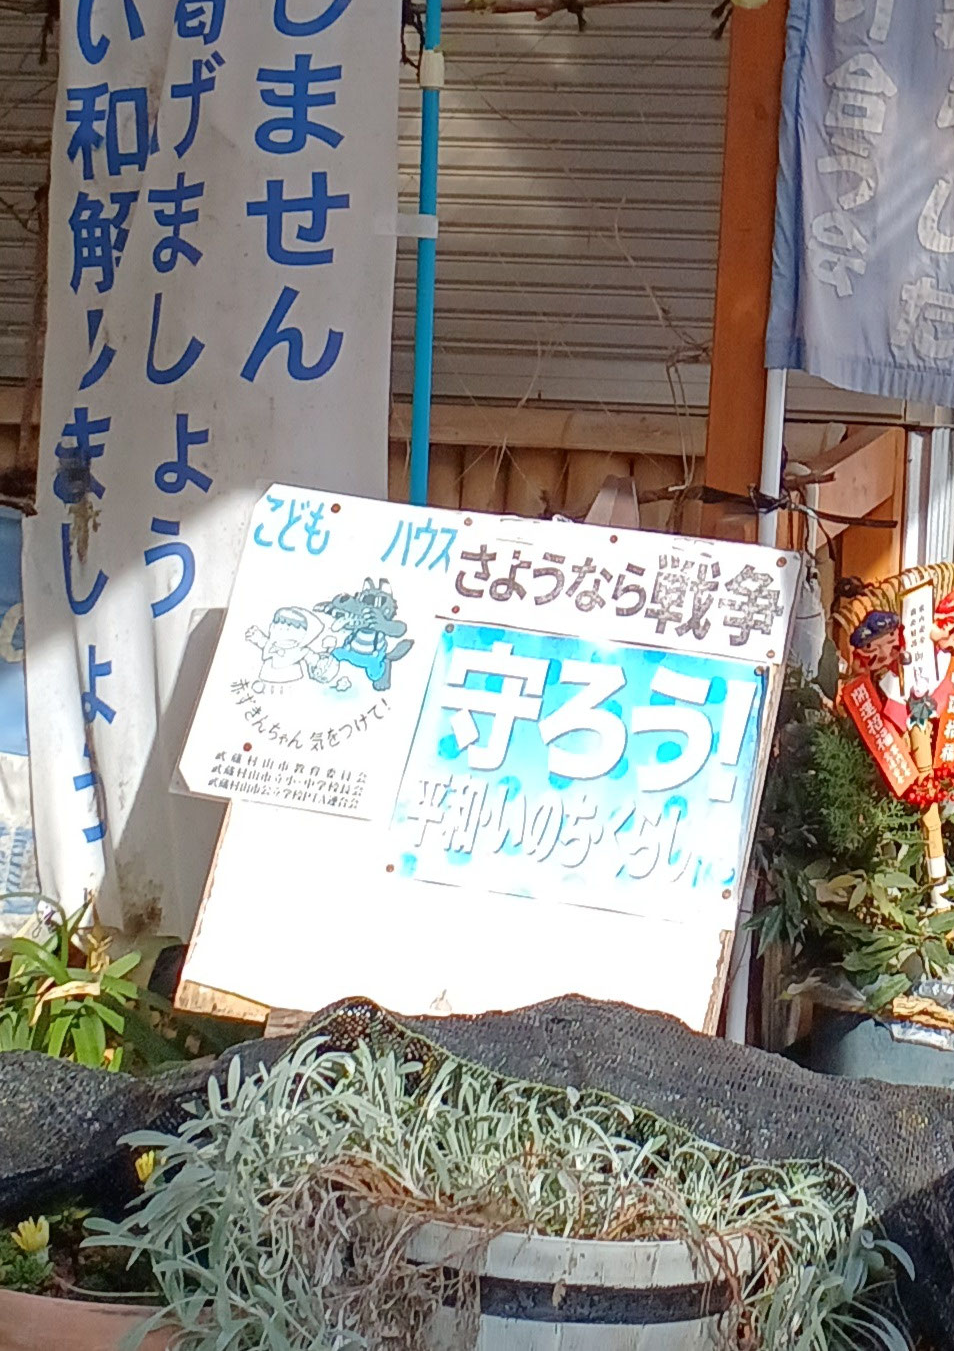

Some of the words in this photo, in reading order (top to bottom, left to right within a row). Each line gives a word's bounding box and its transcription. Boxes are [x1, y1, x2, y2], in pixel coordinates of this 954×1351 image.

[254, 494, 331, 556] こども
[380, 517, 459, 574] ハウス
[454, 544, 785, 647] さようなら戦争
[230, 677, 304, 751] 赤ずきんちゃん
[440, 642, 762, 803] 守ろう!
